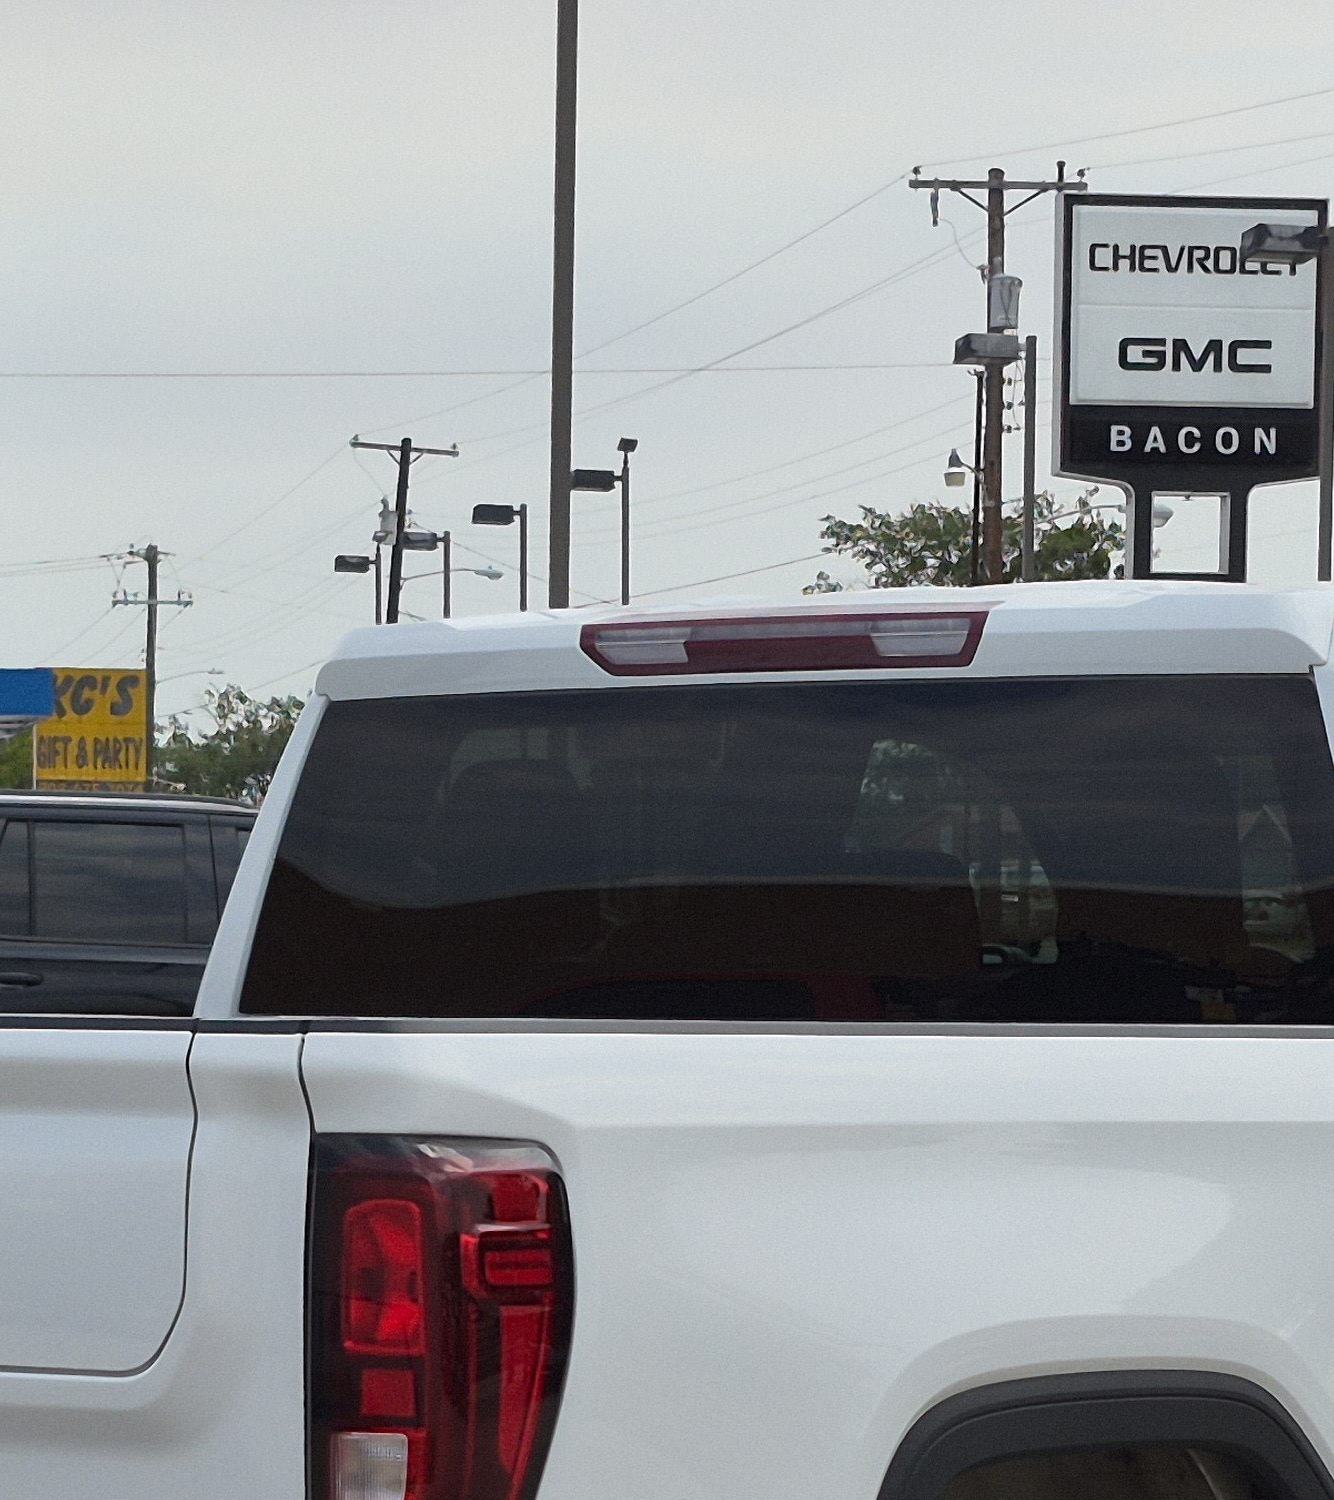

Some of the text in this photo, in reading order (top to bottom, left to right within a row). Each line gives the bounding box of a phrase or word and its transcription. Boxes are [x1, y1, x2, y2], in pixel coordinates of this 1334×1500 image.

[1118, 337, 1273, 374] GMC
[1109, 424, 1278, 455] BACON
[37, 735, 143, 771] GIFT & PARTY
